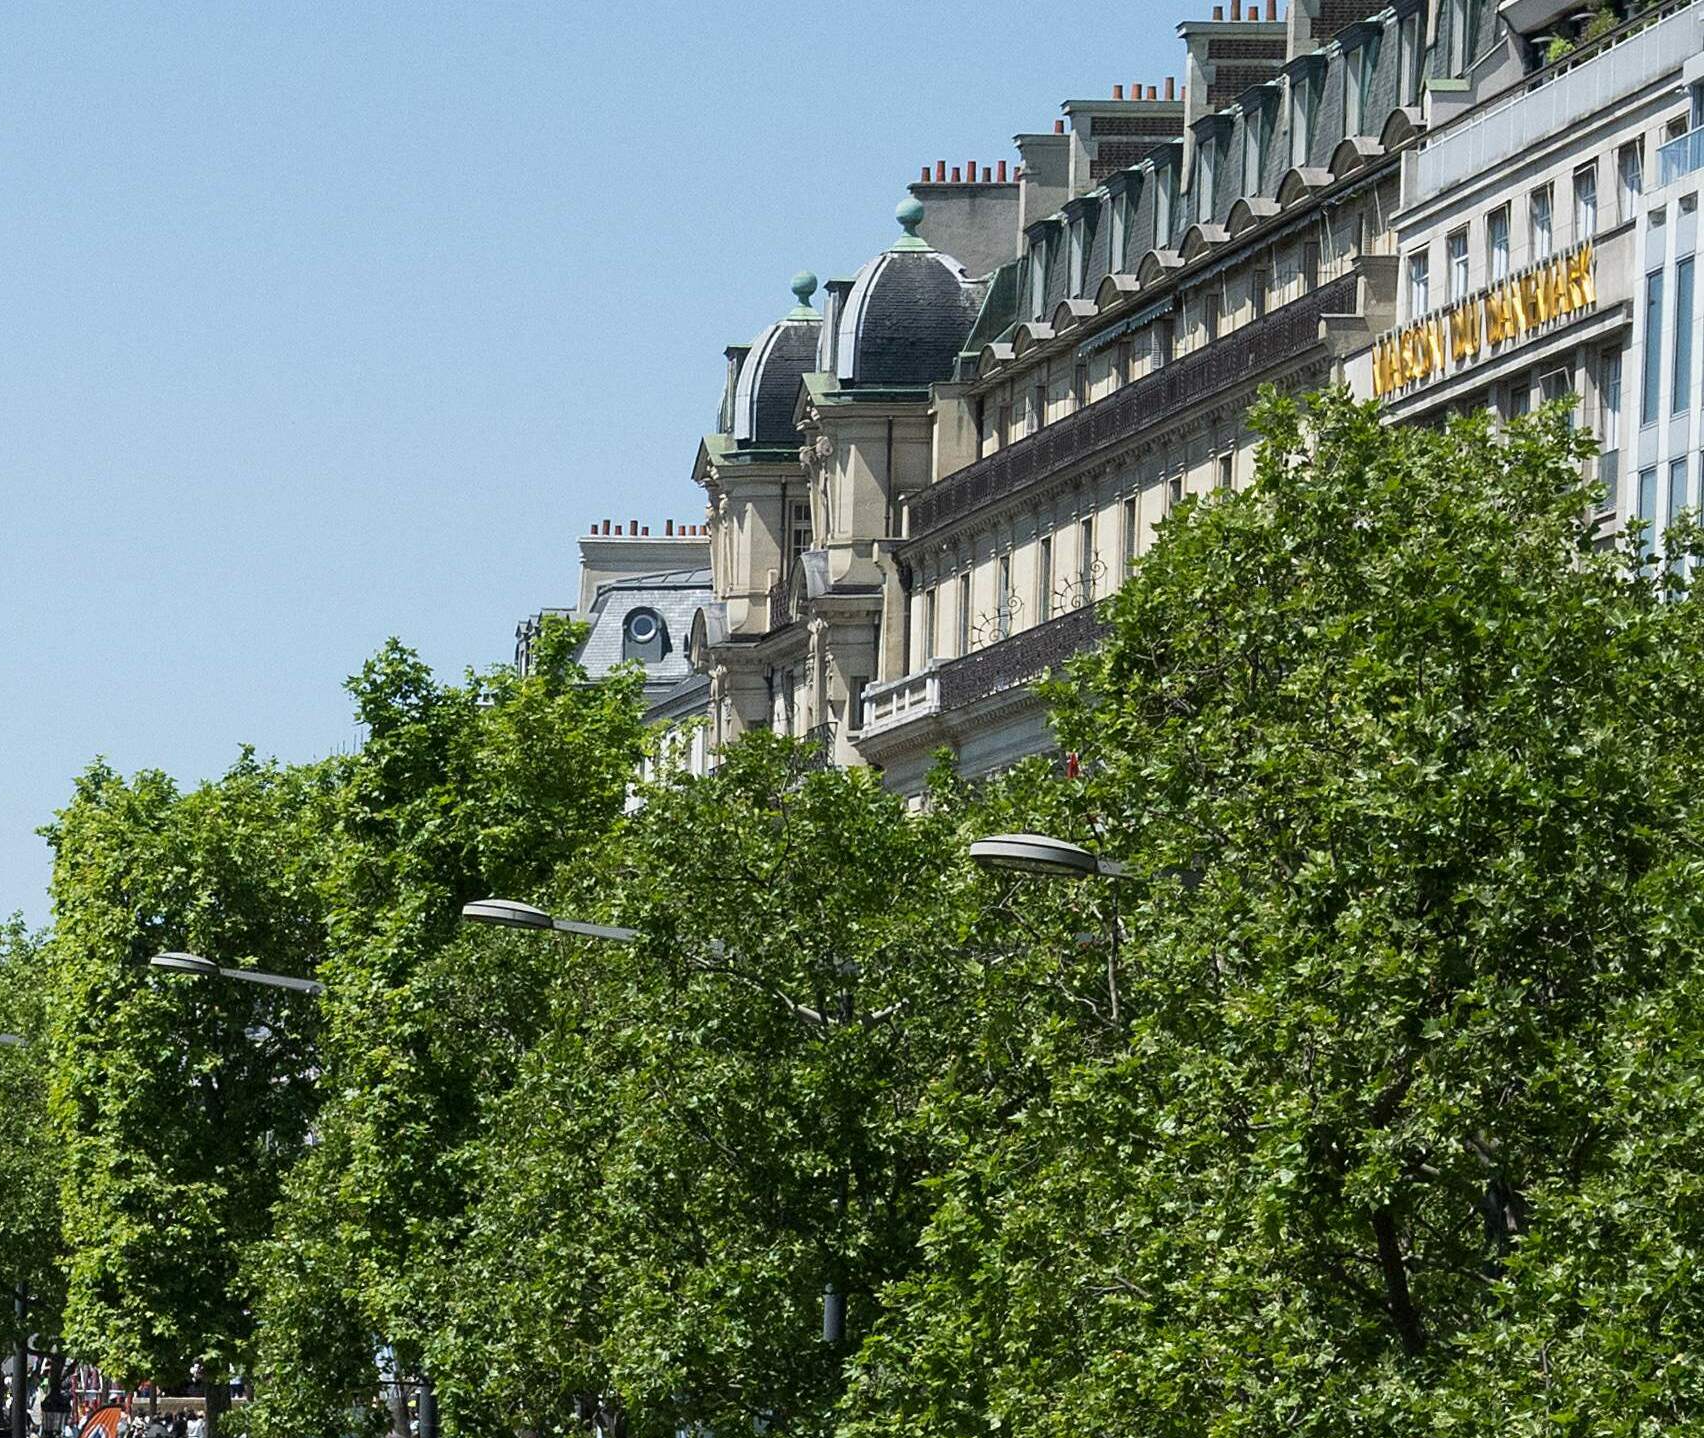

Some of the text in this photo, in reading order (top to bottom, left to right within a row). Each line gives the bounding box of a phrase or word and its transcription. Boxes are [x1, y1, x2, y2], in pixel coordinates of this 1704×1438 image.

[1372, 238, 1596, 397] MAISON DU DANEMARK
